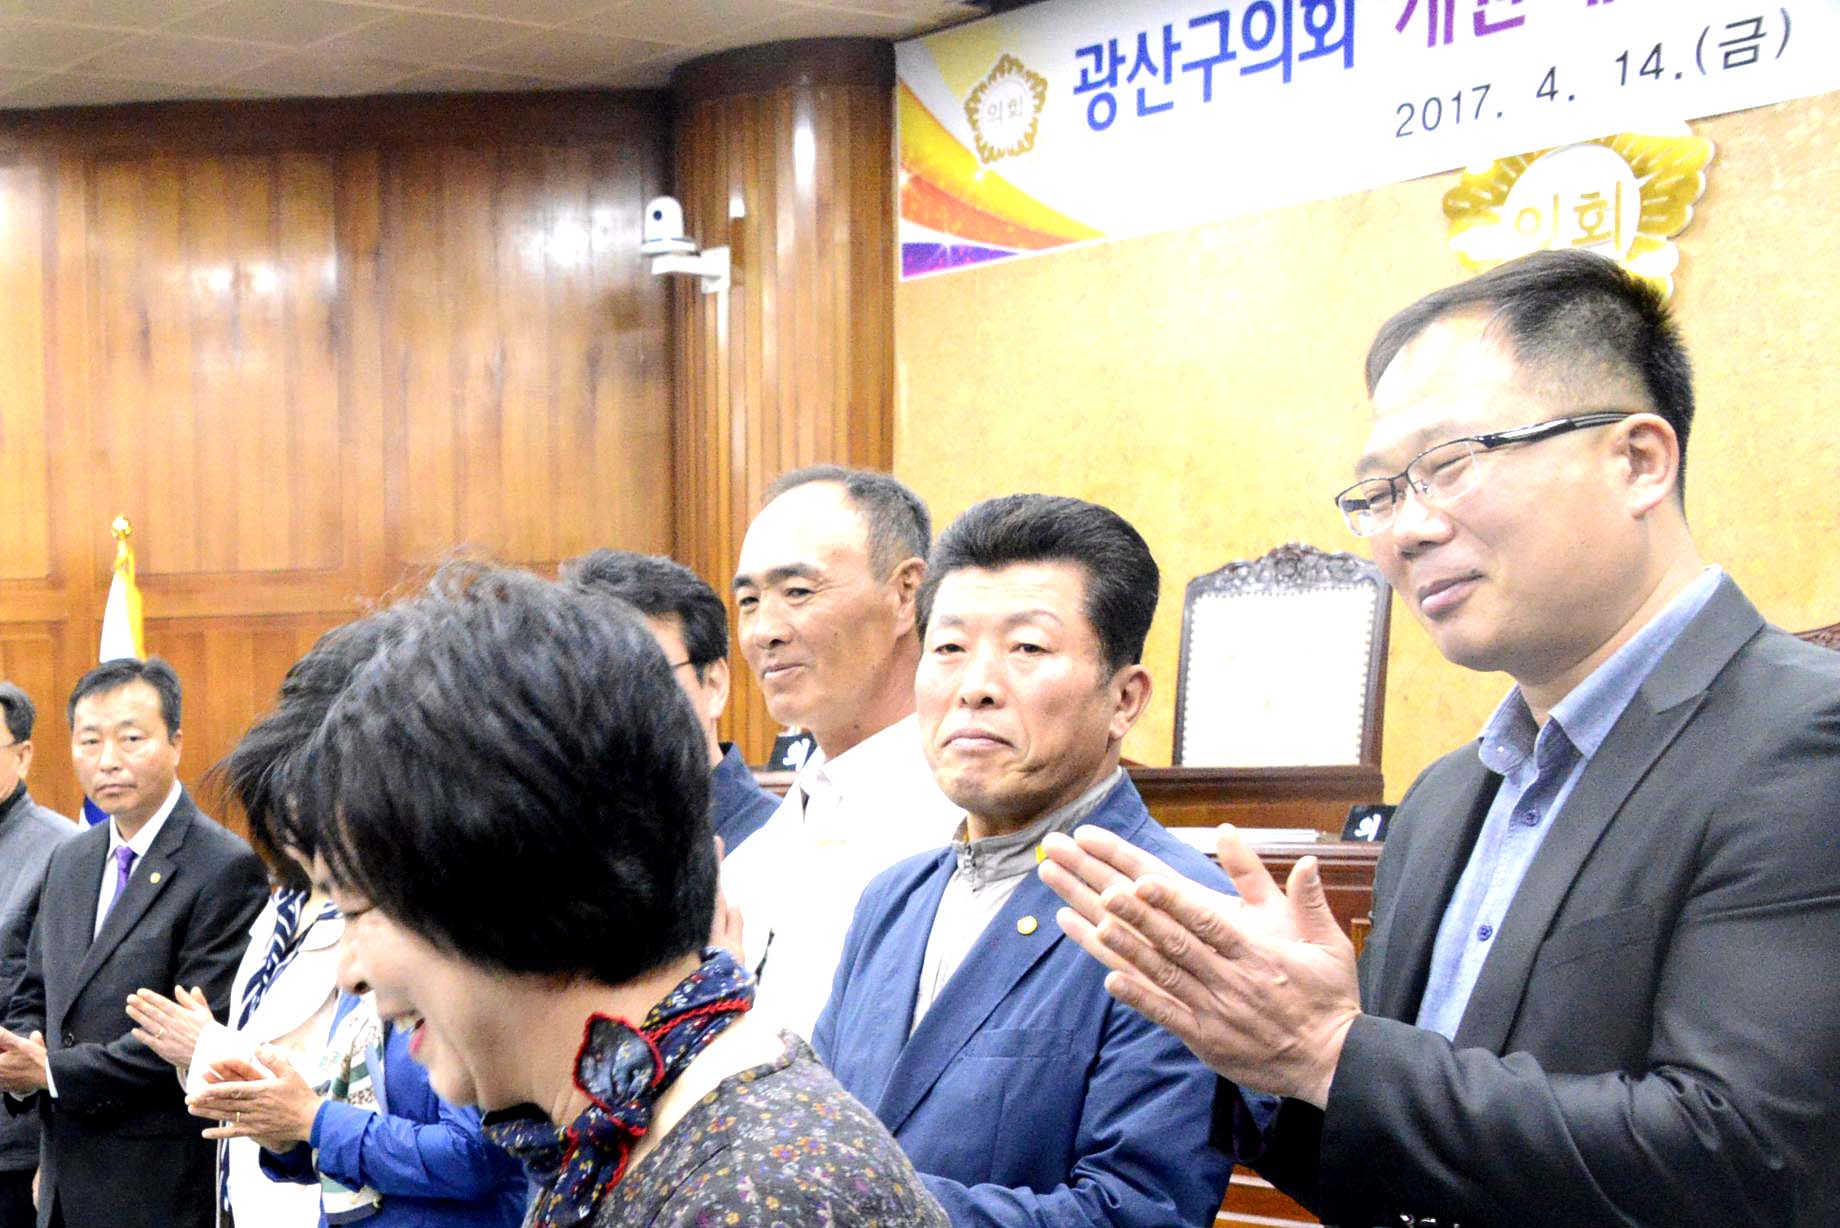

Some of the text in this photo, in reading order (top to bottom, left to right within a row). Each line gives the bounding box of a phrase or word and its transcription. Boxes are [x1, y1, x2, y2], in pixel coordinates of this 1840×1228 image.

[1072, 0, 1356, 132] 광산구의회
[1395, 83, 1504, 139] 2017.
[1535, 66, 1576, 103] 4.
